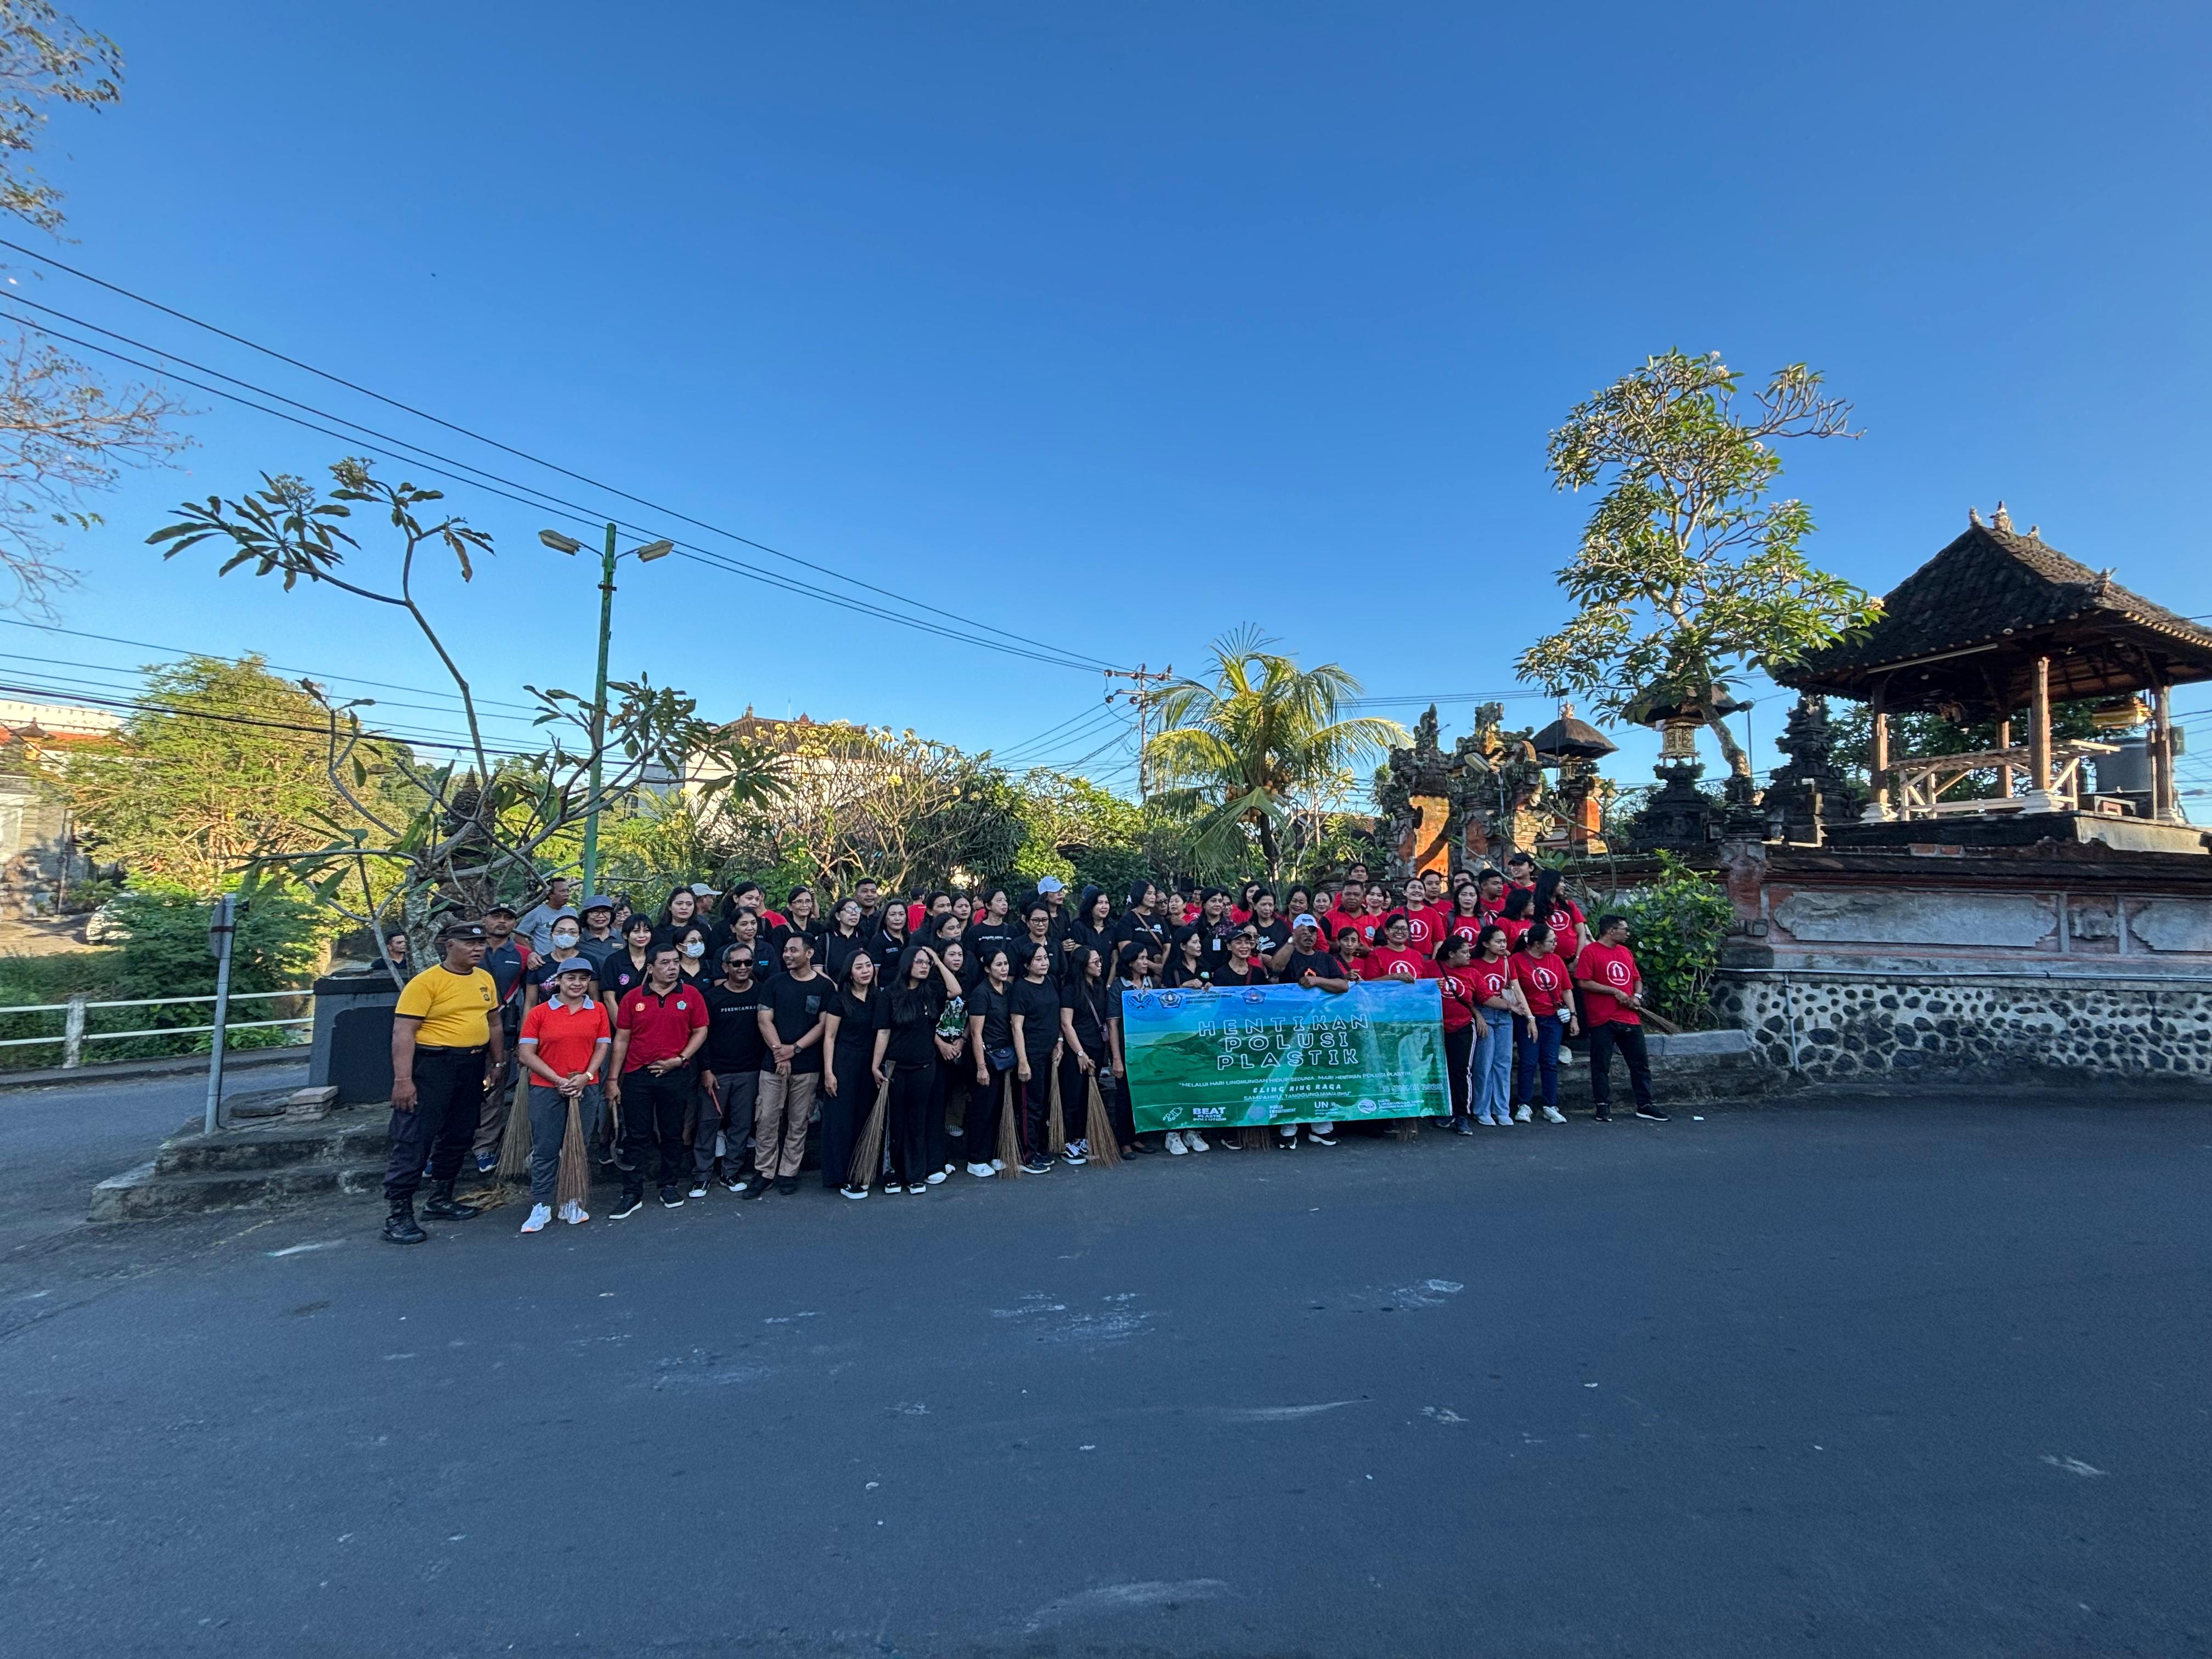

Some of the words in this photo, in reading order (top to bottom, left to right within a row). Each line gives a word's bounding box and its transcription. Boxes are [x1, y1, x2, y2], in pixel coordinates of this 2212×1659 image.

[1199, 1014, 1368, 1036] HENTIKAN
[1224, 1032, 1348, 1052] POLUSI
[1217, 1049, 1359, 1070] PLASTIK
[1193, 1107, 1226, 1115] BEAT
